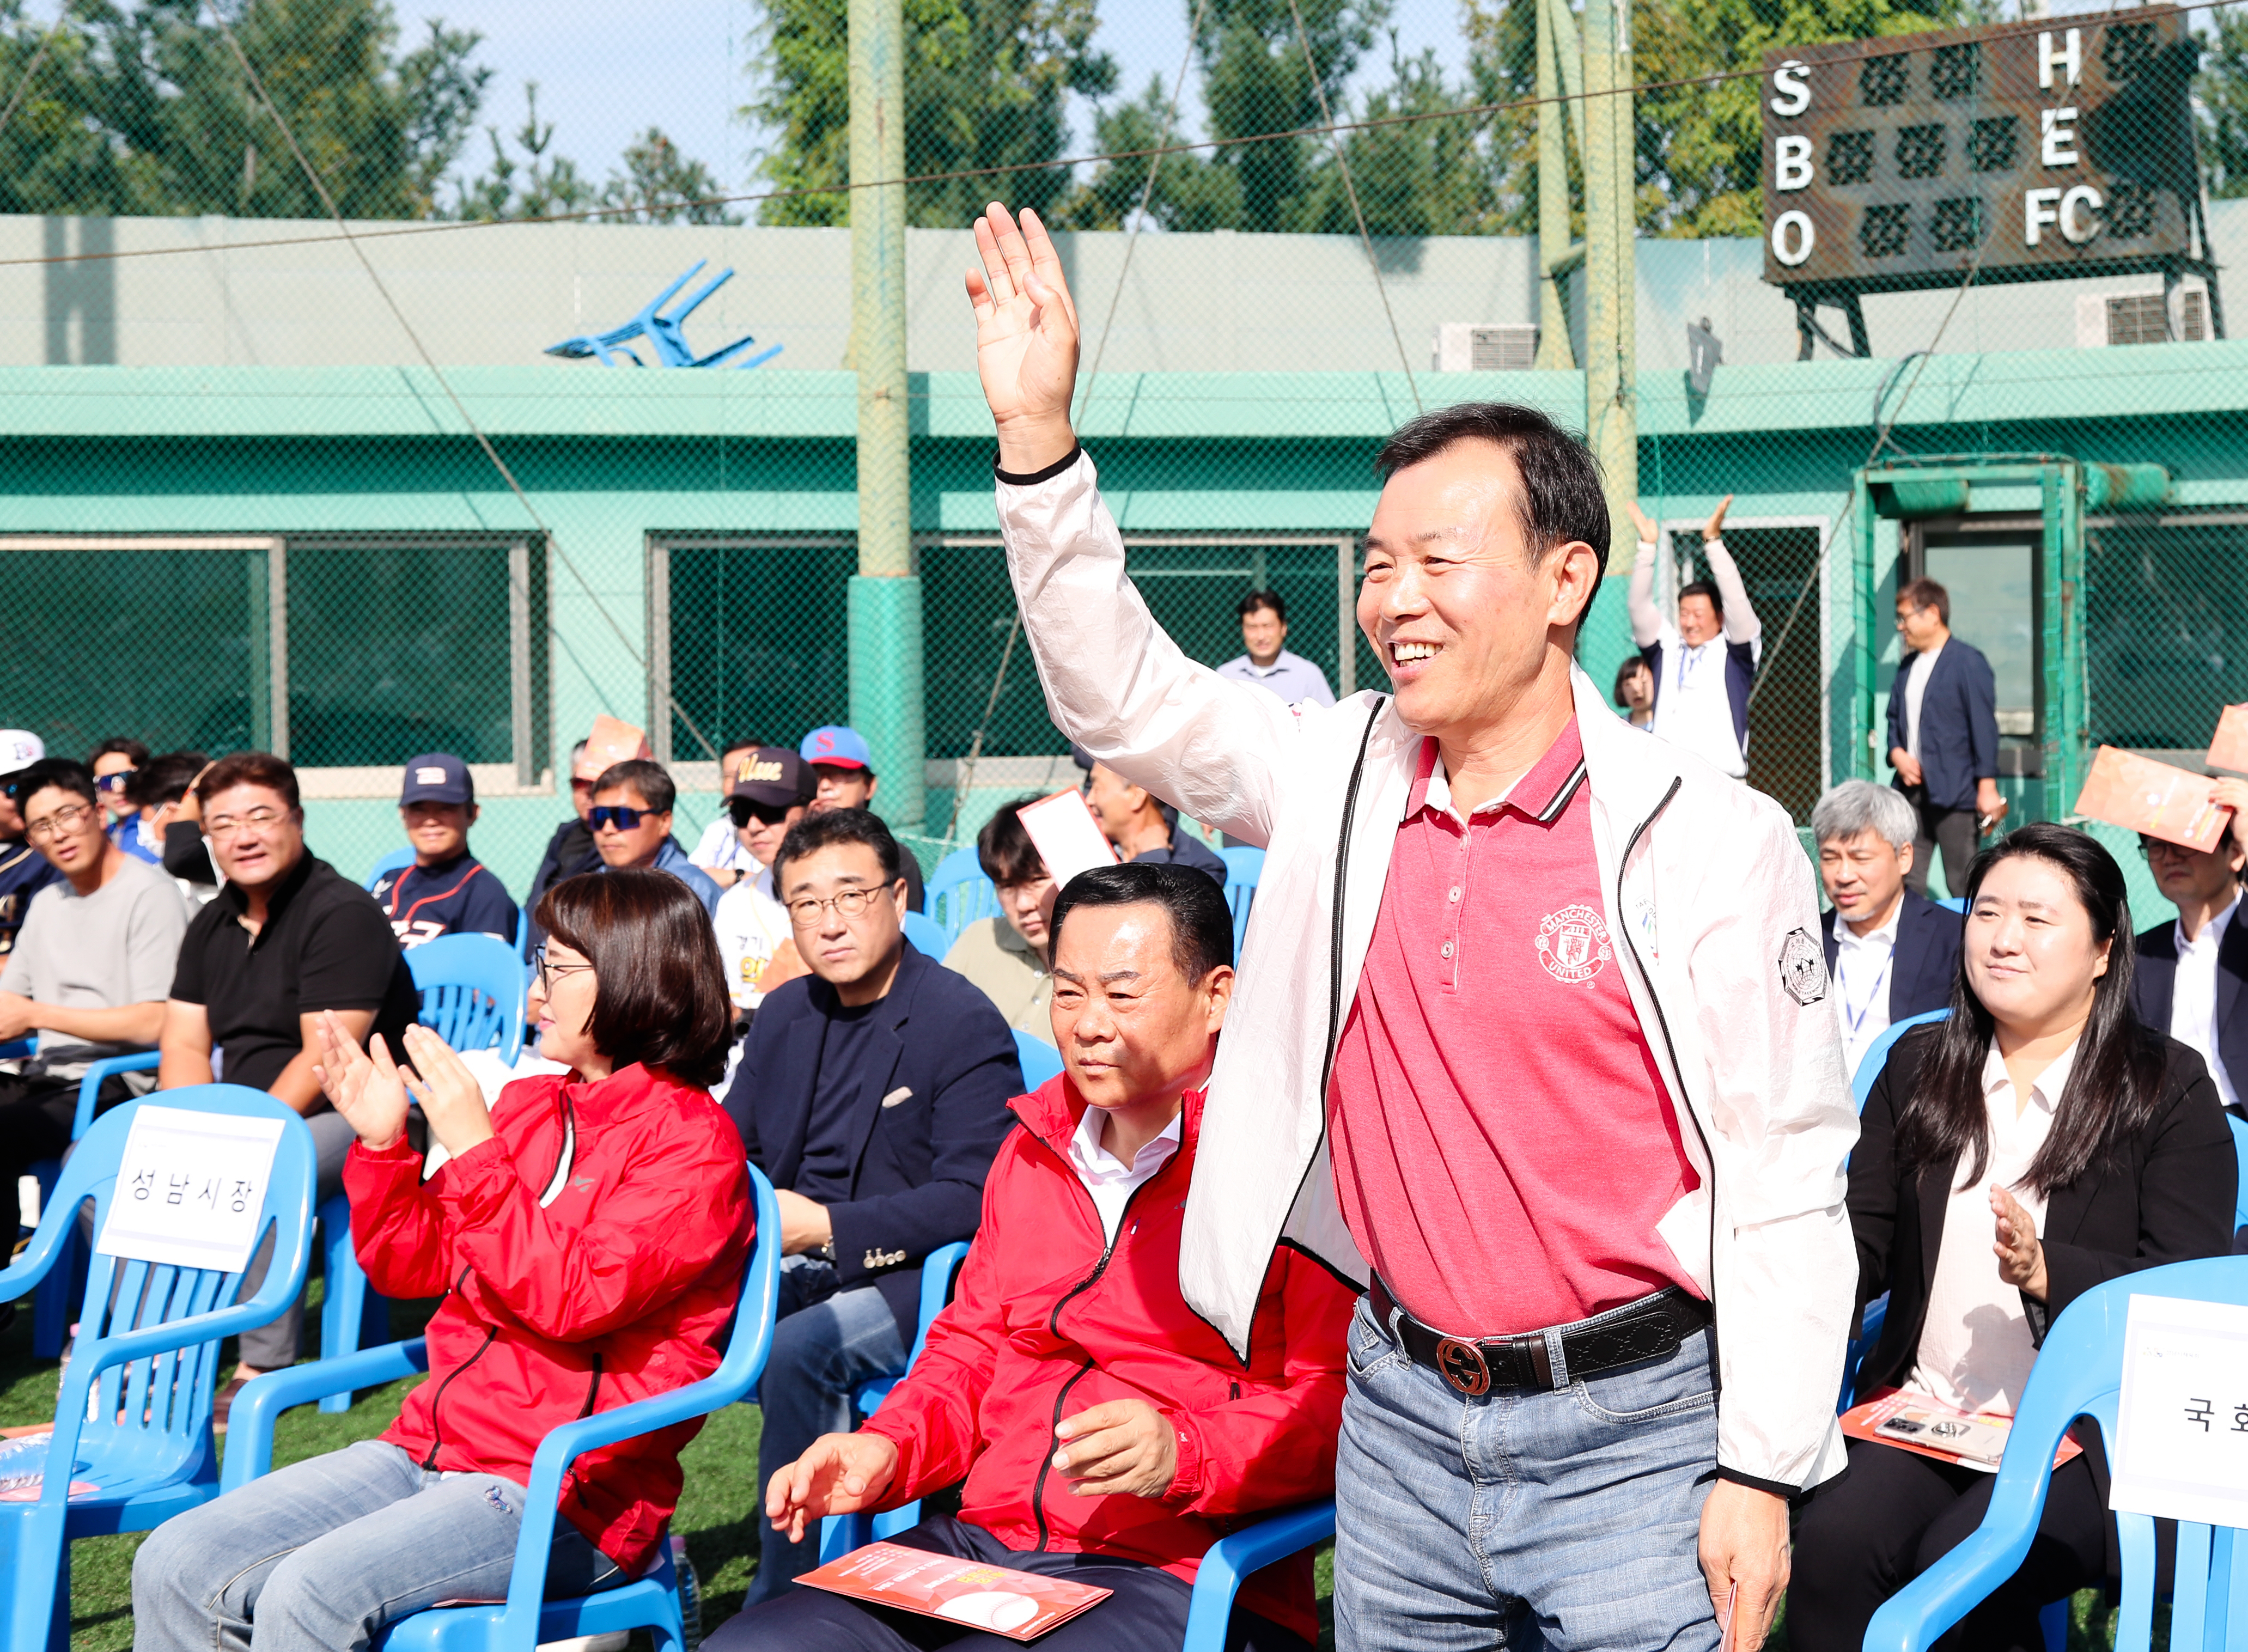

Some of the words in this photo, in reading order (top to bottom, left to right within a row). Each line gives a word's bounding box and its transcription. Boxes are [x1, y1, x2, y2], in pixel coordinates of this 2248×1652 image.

[2038, 28, 2081, 88] H
[1770, 60, 1812, 117] S
[1775, 135, 1814, 191] B
[2041, 107, 2078, 166] E
[1771, 210, 1815, 266] O
[2024, 185, 2103, 245] FC
[817, 732, 834, 752] S
[1546, 910, 1607, 941] MANCHESTER
[1549, 961, 1592, 978] UNITED
[132, 1169, 252, 1212] 성남시장
